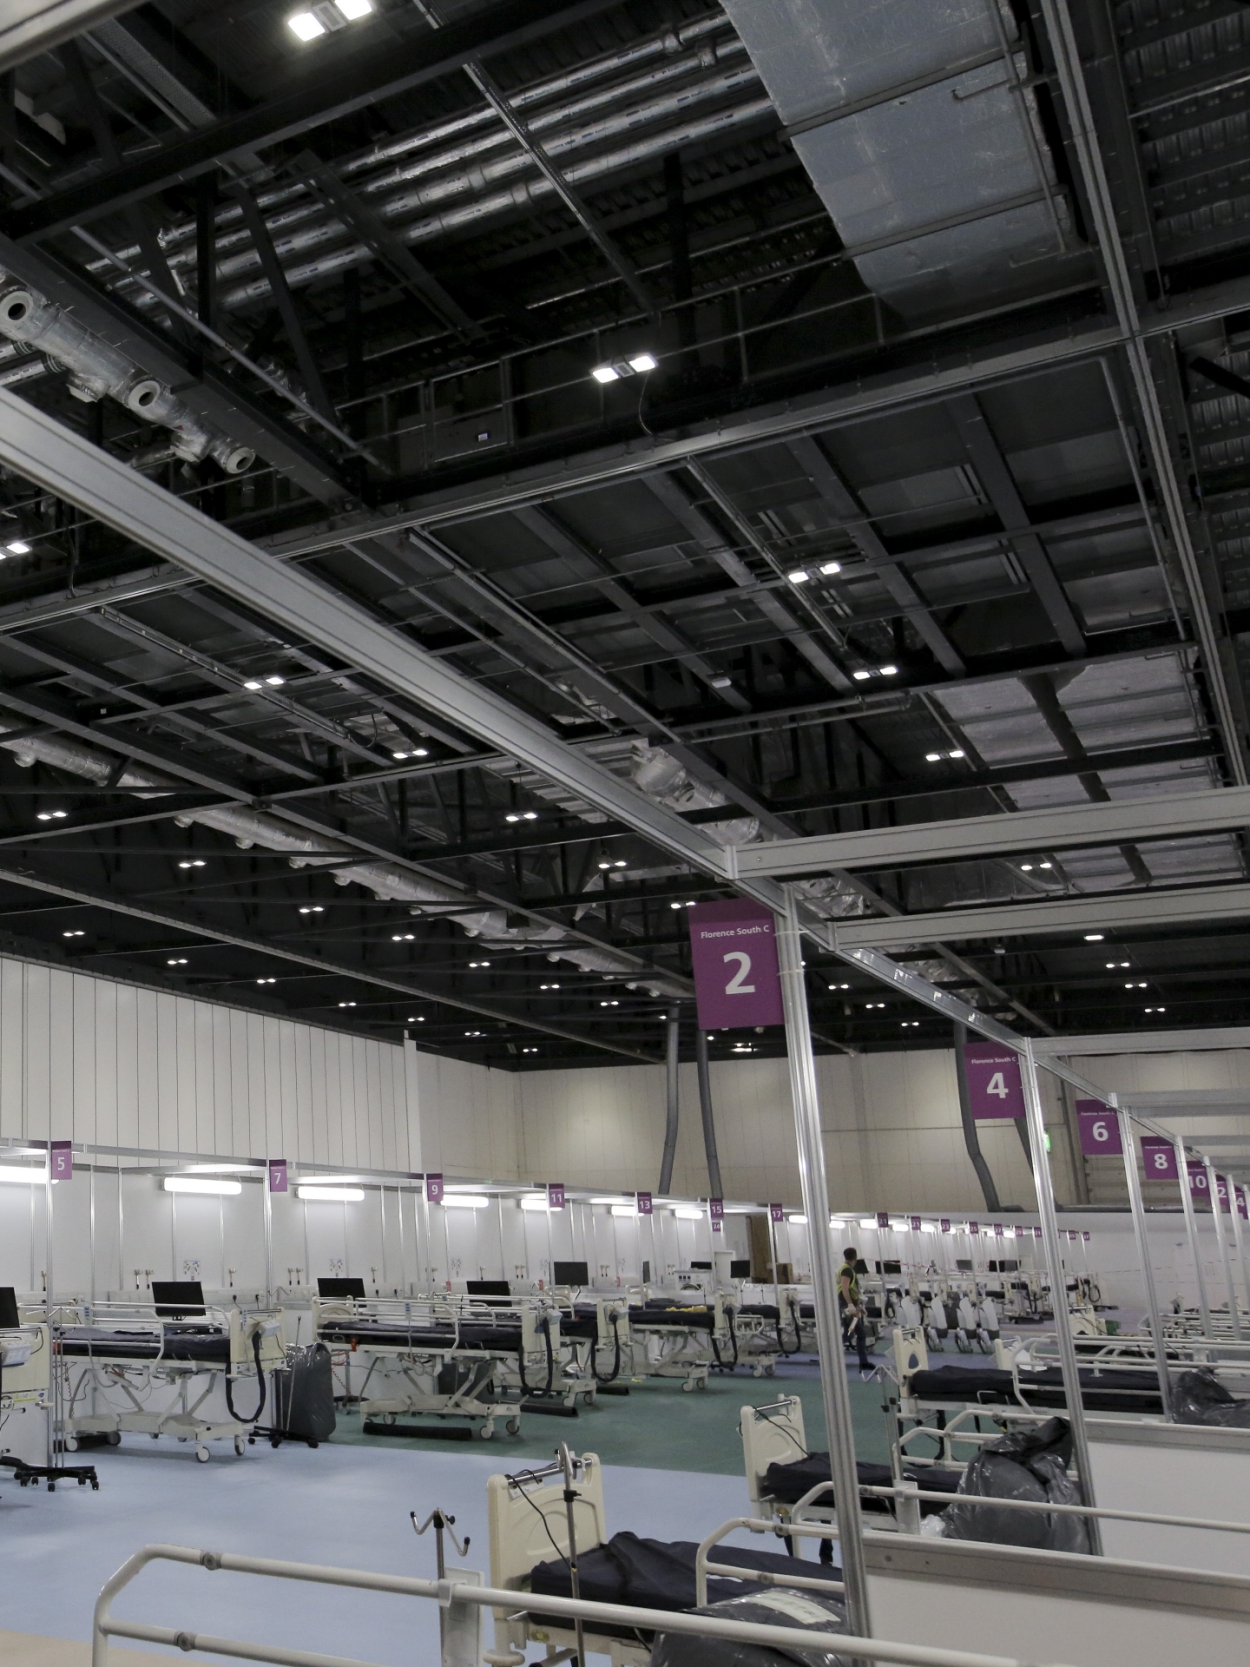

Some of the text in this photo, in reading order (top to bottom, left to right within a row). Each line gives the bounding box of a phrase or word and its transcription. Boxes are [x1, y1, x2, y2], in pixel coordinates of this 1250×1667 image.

[700, 924, 770, 939] Florence South C
[723, 951, 755, 994] 2
[986, 1072, 1009, 1099] 4
[1092, 1121, 1109, 1142] 6
[57, 1156, 65, 1171] 5
[1154, 1153, 1168, 1170] 8
[274, 1172, 281, 1184] 7
[1188, 1175, 1207, 1189] 10
[431, 1184, 439, 1195] 9
[1217, 1186, 1227, 1198] 2
[551, 1193, 562, 1203] 11
[639, 1200, 650, 1210] 13
[712, 1205, 722, 1214] 15
[772, 1210, 781, 1218] 17
